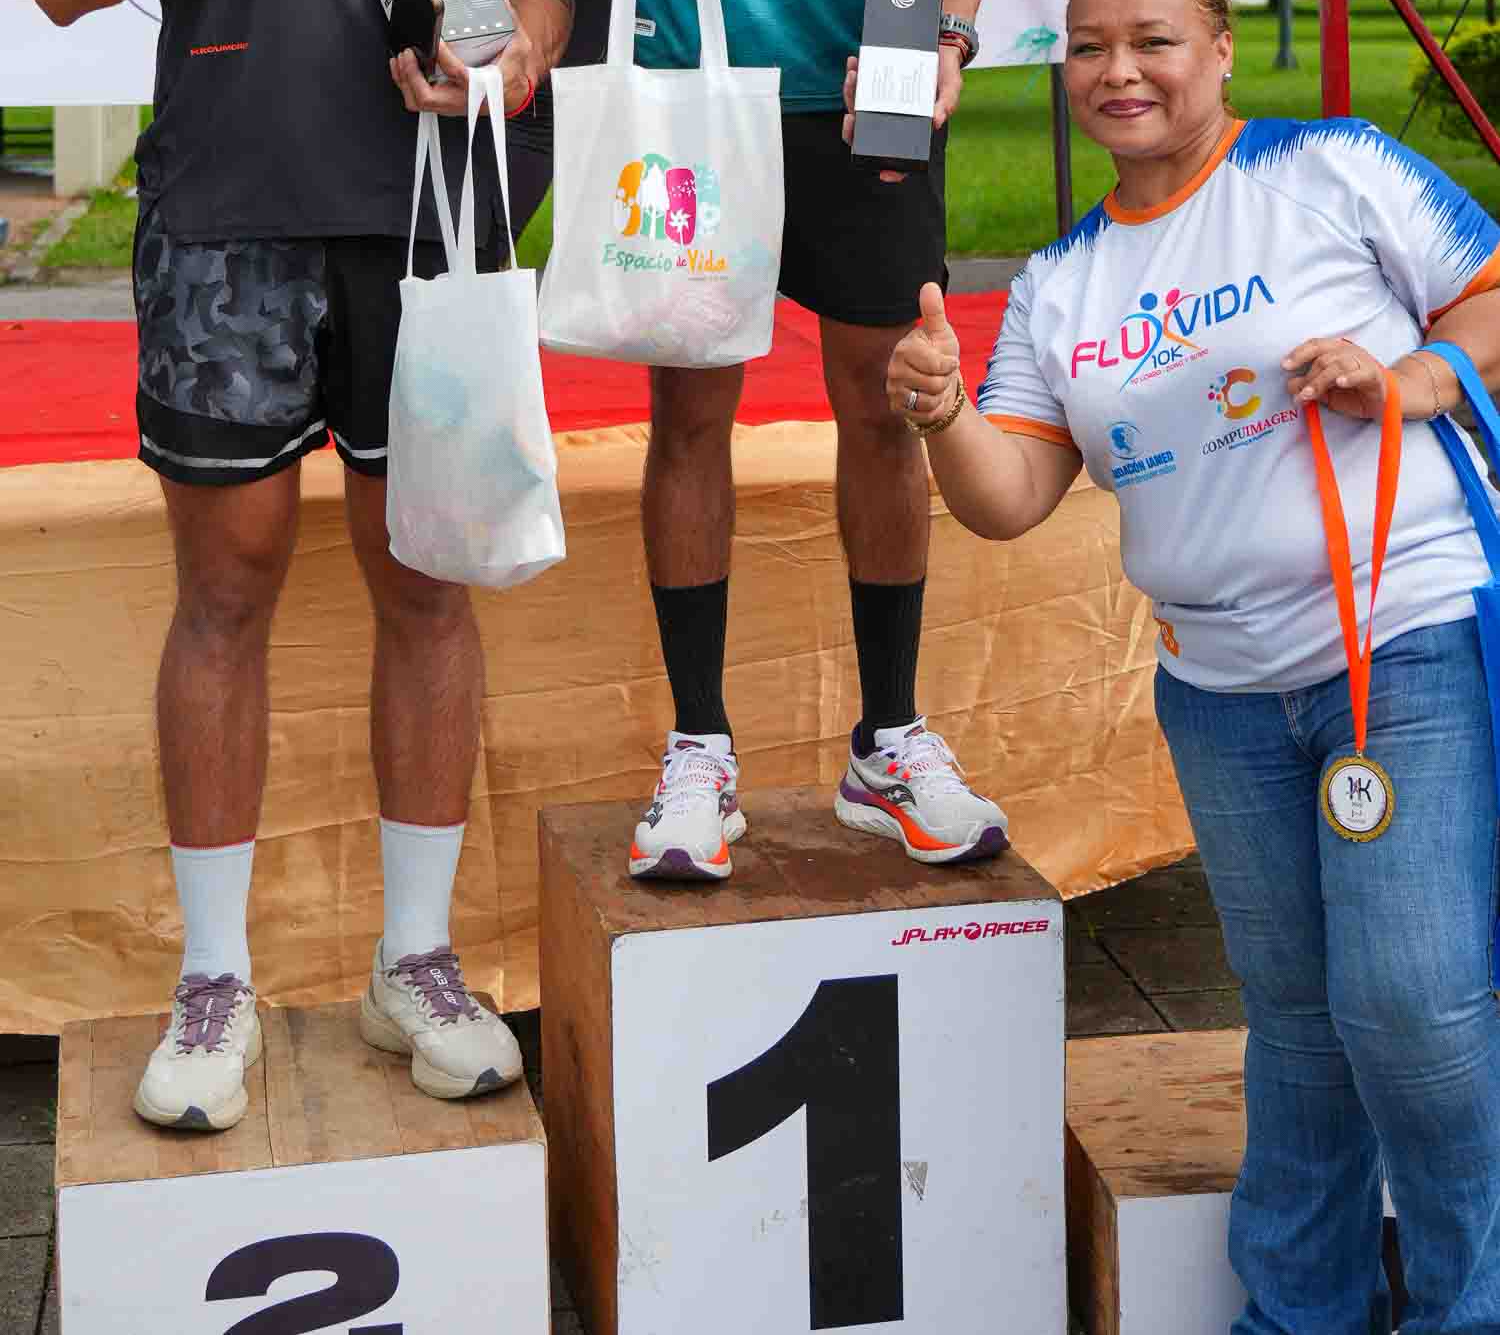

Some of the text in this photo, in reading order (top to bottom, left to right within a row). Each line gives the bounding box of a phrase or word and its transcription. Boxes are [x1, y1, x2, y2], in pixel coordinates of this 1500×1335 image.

[601, 243, 672, 272] Espacio
[688, 249, 728, 274] Vida
[1152, 345, 1184, 369] 10K
[1202, 409, 1299, 456] COMPUIMAGEN
[891, 920, 1050, 946] JPLAY RACES
[706, 973, 904, 1330] 1
[206, 1232, 403, 1335] 2
